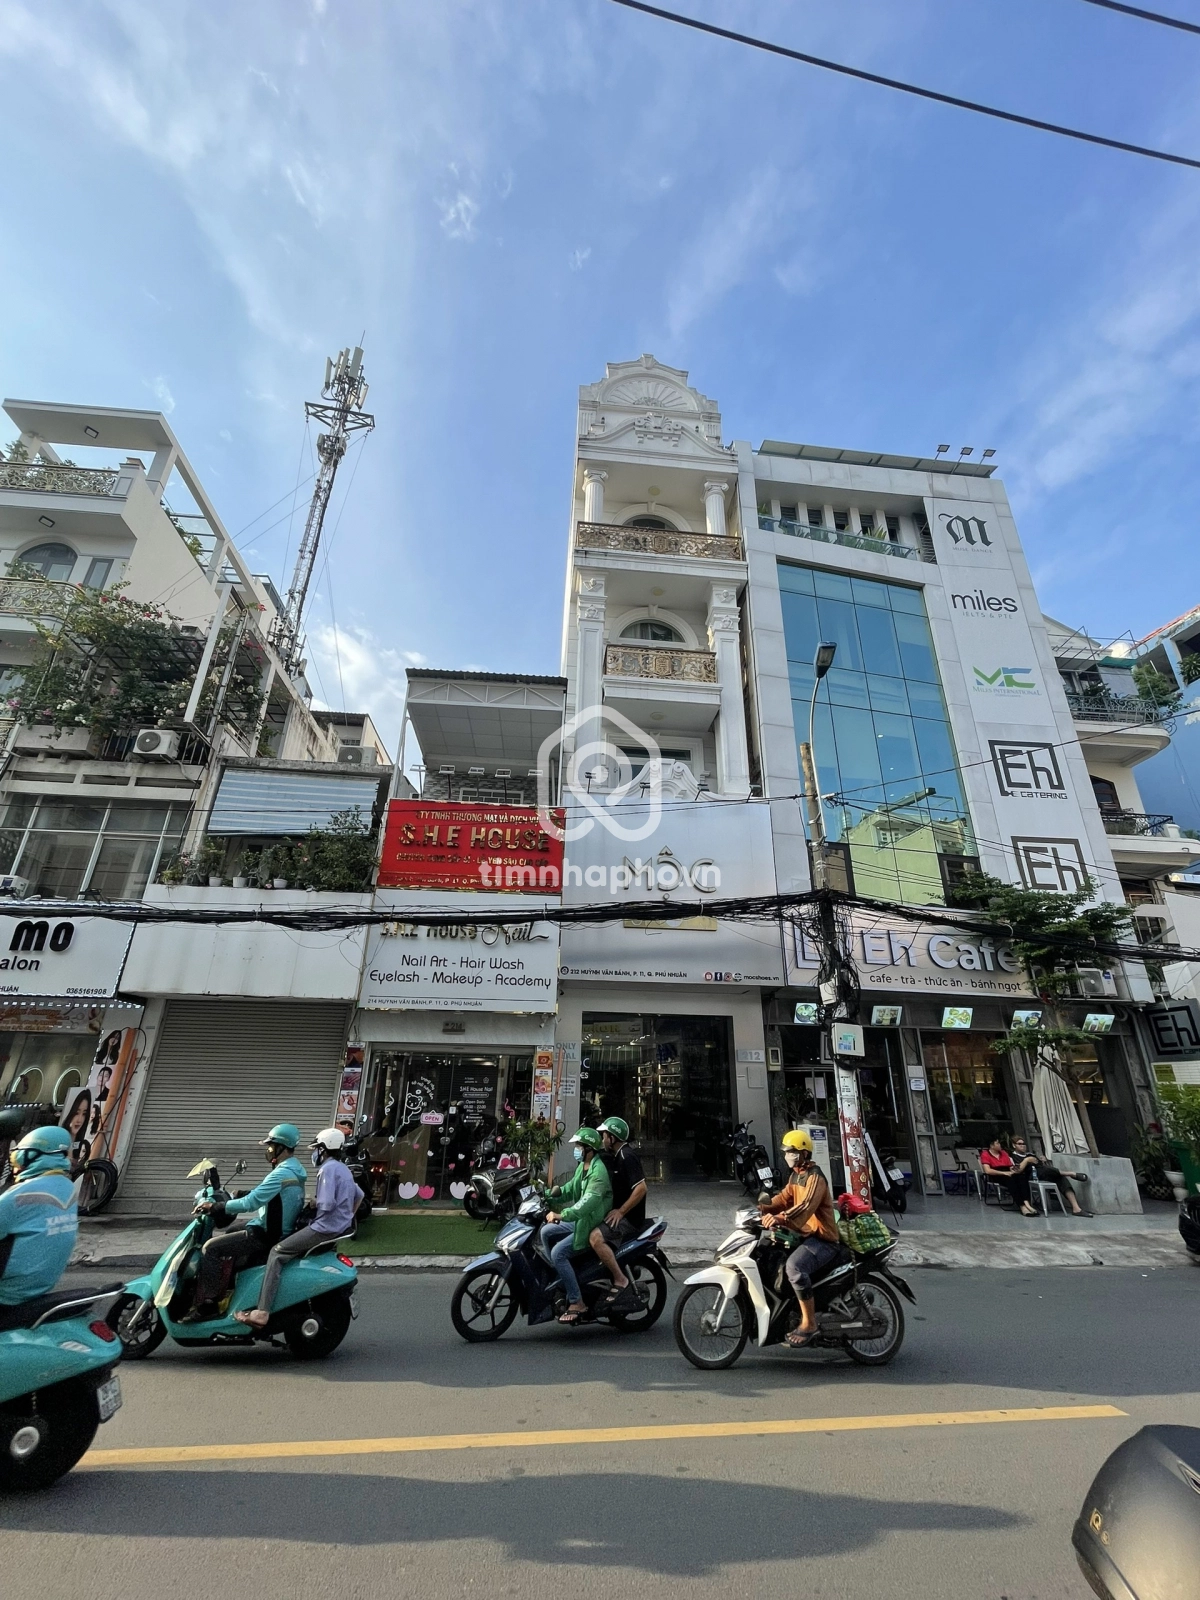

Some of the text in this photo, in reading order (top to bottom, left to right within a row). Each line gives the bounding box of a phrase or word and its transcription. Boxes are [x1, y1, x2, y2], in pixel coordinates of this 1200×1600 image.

[951, 589, 1018, 613] miles
[399, 822, 550, 852] S.H.E HOUSE
[402, 955, 427, 967] Nail
[430, 956, 448, 968] Art
[460, 957, 486, 969] Hair
[490, 957, 525, 970] Wash
[370, 970, 420, 985] Eyelash
[432, 972, 483, 988] Makeup
[495, 973, 552, 990] Academy
[870, 973, 892, 983] cafe
[901, 974, 915, 985] trà
[924, 976, 948, 987] thức
[950, 977, 963, 988] ăn
[971, 978, 997, 990] bánh
[998, 981, 1021, 993] ngọt
[742, 1051, 761, 1060] 212
[611, 1124, 622, 1134] Grab
[584, 1135, 596, 1143] Grab
